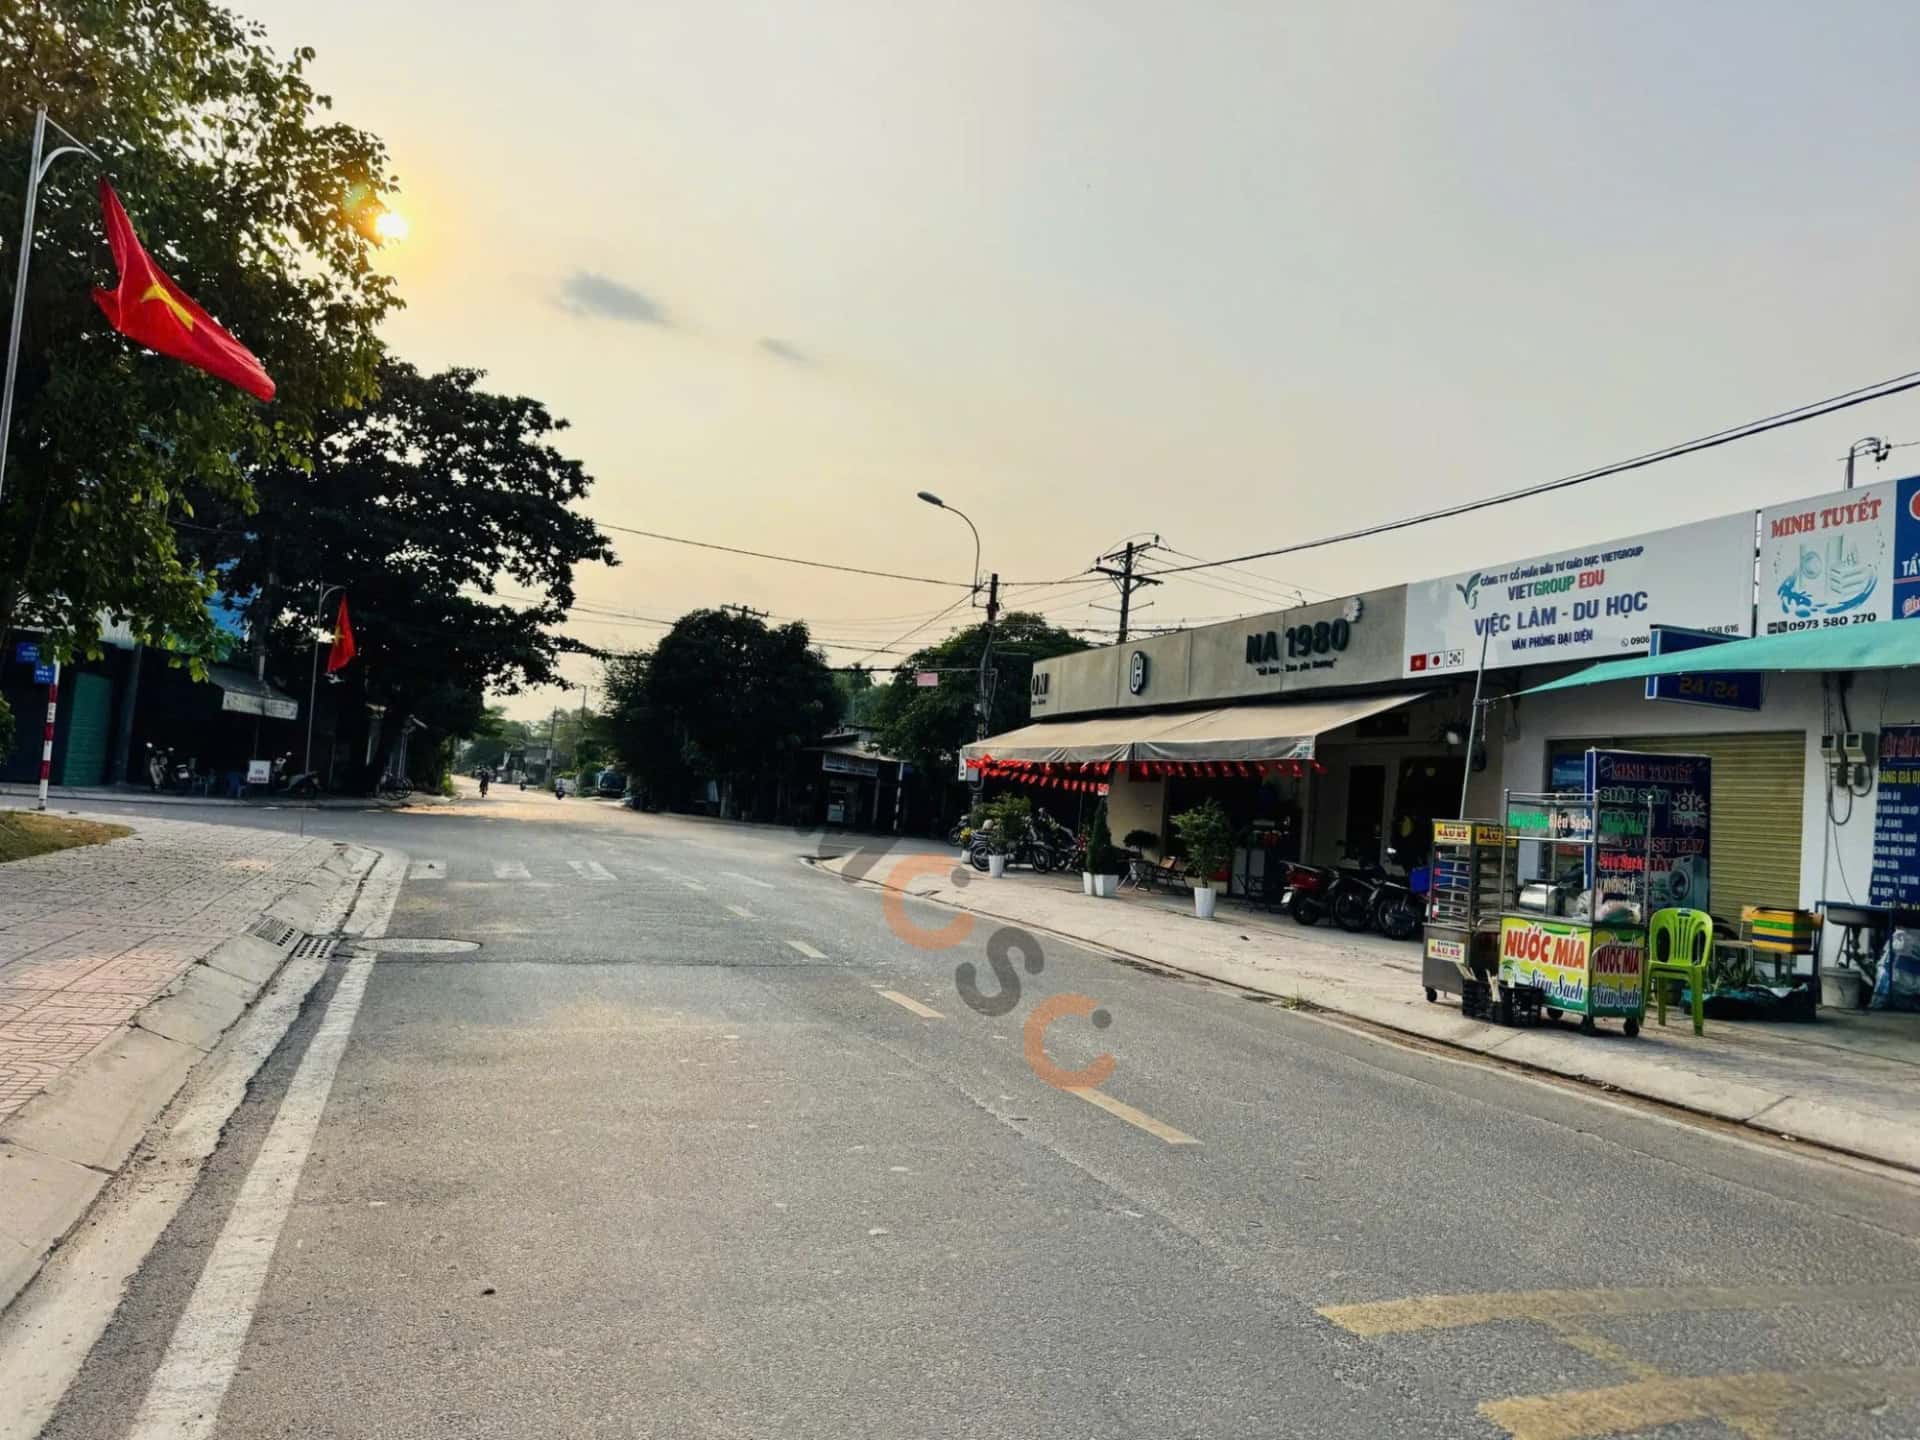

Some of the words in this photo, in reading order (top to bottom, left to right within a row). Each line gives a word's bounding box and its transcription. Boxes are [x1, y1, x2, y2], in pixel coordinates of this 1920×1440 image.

[1771, 512, 1816, 538] MINH
[1820, 492, 1882, 529] TUYẾT
[1499, 574, 1508, 583] TY
[1600, 545, 1644, 563] VIETGROUP
[1508, 575, 1575, 600] VIETGROUP
[1578, 569, 1605, 589] EDU
[1474, 612, 1511, 637] VIỆC
[1517, 606, 1557, 630] LÀM
[1573, 600, 1599, 621] DU
[1606, 591, 1648, 619] HỌC
[1788, 618, 1819, 632] 0973
[1823, 615, 1848, 628] 580
[1853, 612, 1877, 624] 270
[1246, 630, 1280, 664] NA
[1286, 617, 1350, 658] 1980
[1573, 629, 1593, 644] DIỆN
[1504, 926, 1550, 964] NƯỚC
[1552, 930, 1585, 969] MÍA
[1622, 934, 1640, 974] MÍA
